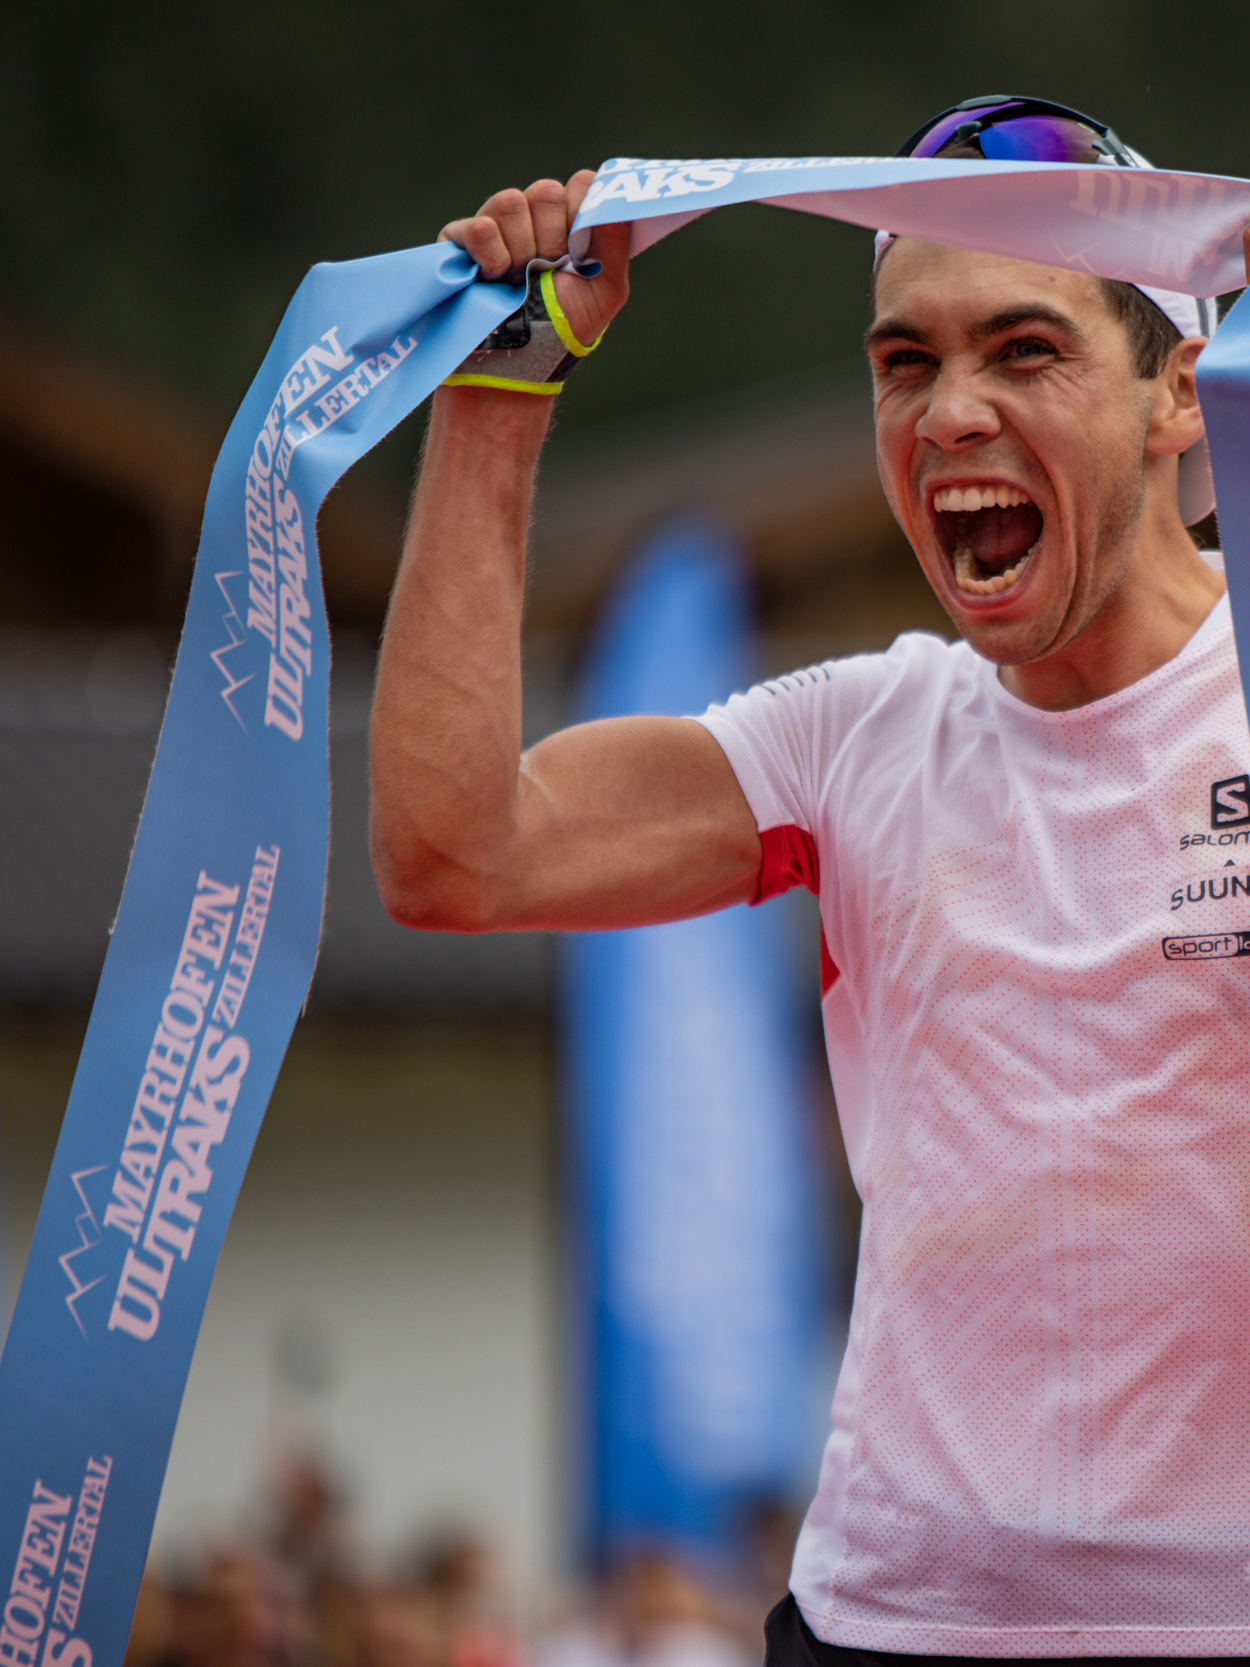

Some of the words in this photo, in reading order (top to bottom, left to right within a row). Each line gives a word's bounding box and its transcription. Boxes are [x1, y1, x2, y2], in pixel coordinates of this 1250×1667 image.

[245, 326, 355, 648] MAYRHOFEN
[264, 474, 311, 742] ULTRAKS
[103, 870, 240, 1245] MAYRHOFEN
[108, 1025, 250, 1342] ULTRAKS
[212, 843, 280, 1029] ZILLERTAL
[0, 1478, 73, 1667] HOFEN
[52, 1454, 113, 1632] ZILLERTAL
